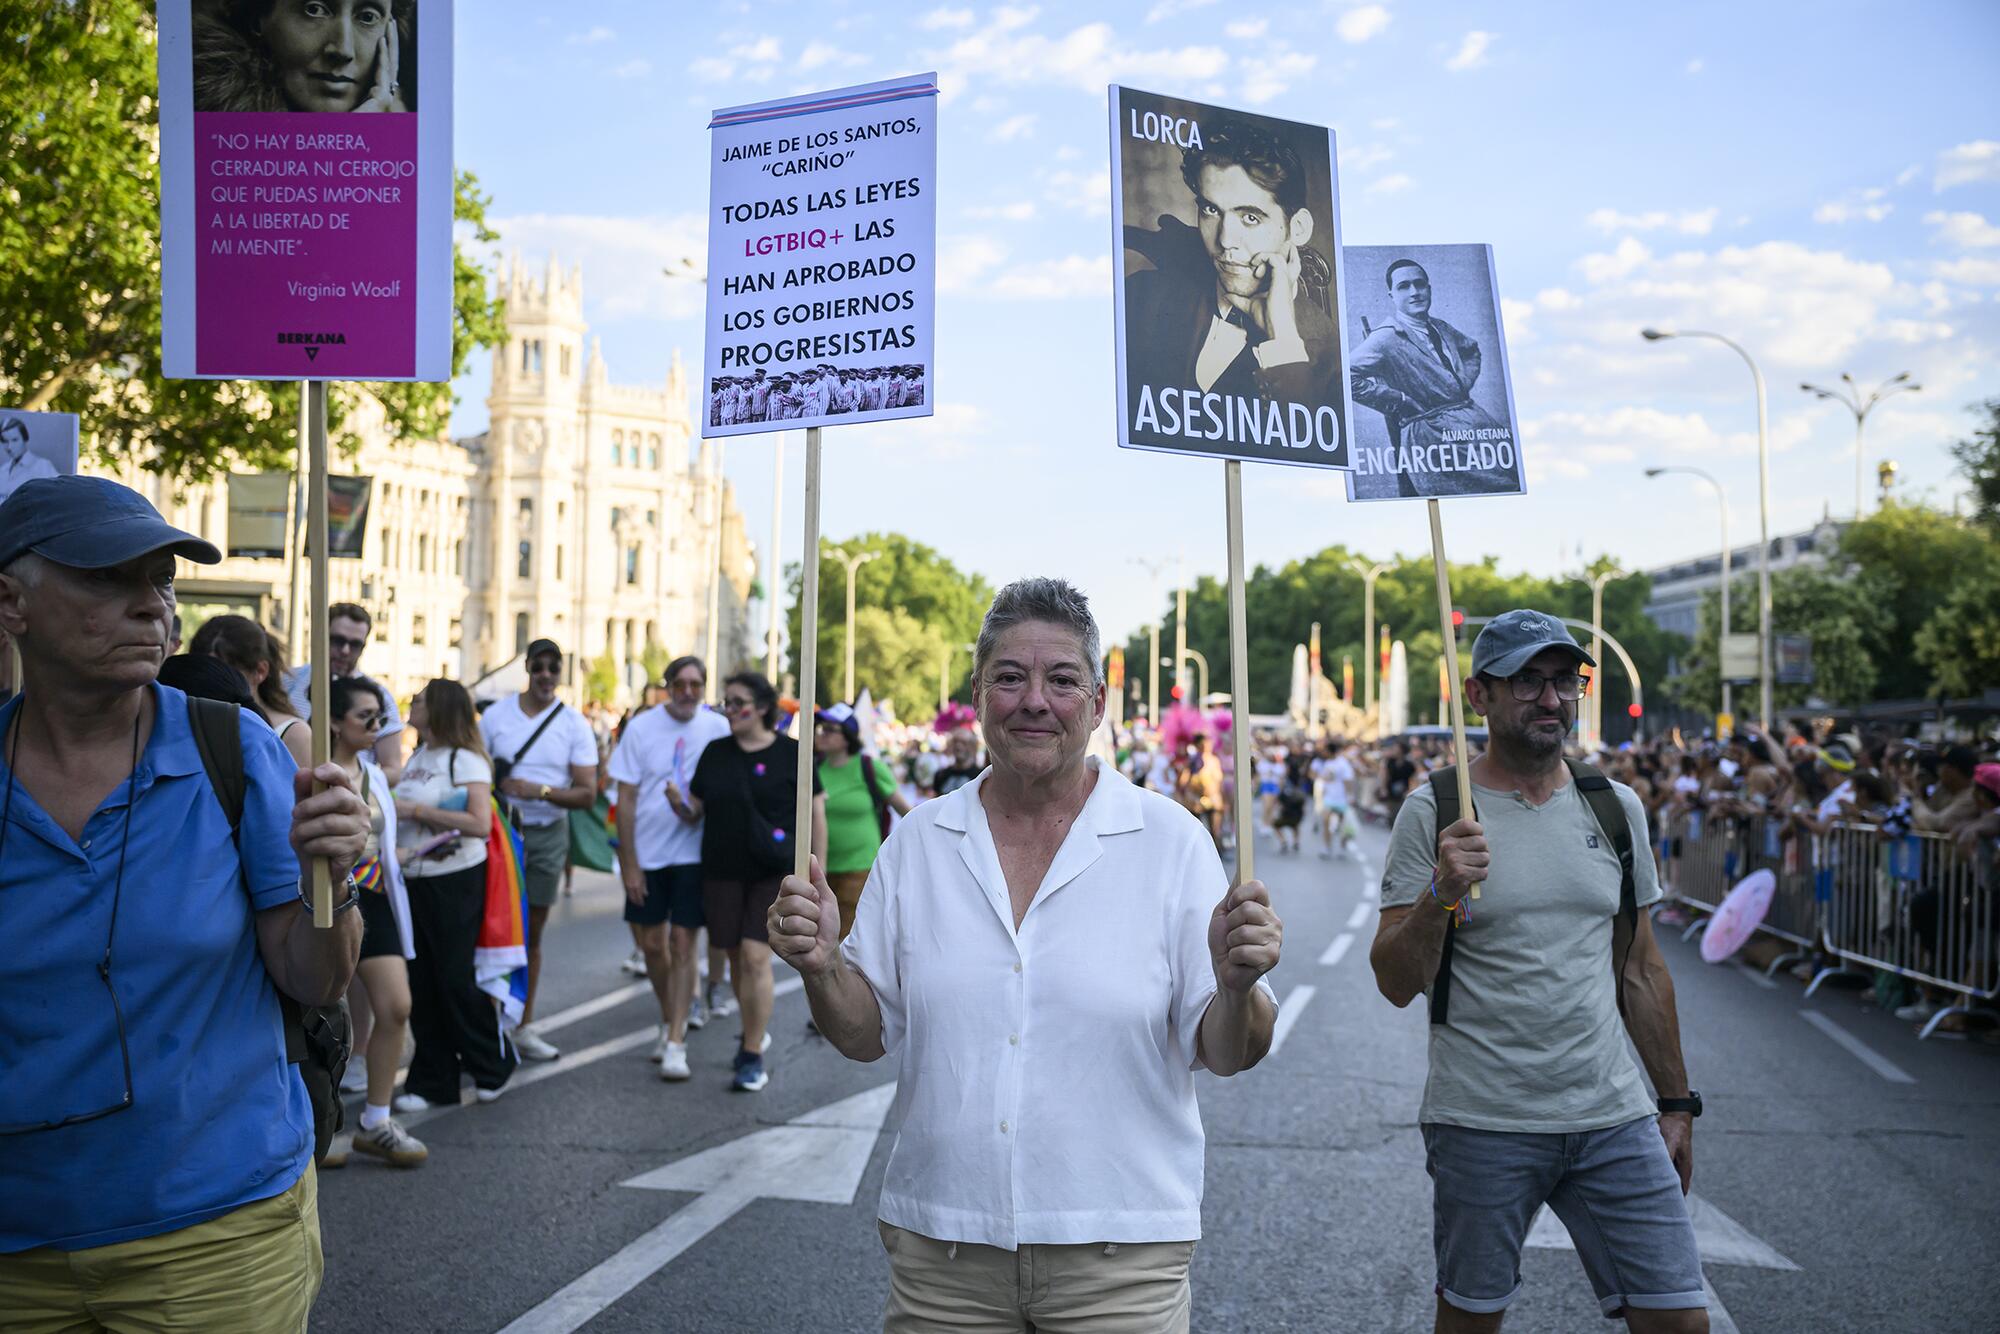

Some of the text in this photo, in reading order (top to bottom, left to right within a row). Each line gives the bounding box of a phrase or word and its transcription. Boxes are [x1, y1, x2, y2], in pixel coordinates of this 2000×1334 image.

[255, 134, 290, 149] HAY
[295, 134, 370, 152] BARRERA,
[722, 117, 921, 162] JAIME DE LOS SANTOS,
[1131, 108, 1203, 151] LORCA
[211, 160, 415, 179] CERRADURA NI CERROJO
[762, 150, 855, 178] “CARIÑO”
[211, 186, 401, 203] QUE PUEDAS IMPONER
[722, 177, 920, 225] TODAS LAS LEYES
[211, 213, 350, 230] A LA LIBERTAD DE
[211, 240, 232, 255] MI
[745, 218, 895, 257] LGTBIQ+ LAS
[724, 252, 916, 296] HAN APROBADO
[287, 280, 401, 302] Virginia Woolf
[724, 290, 914, 332] LOS GOBIERNOS
[277, 333, 346, 345] BERKANA
[721, 324, 916, 369] PROGRESISTAS
[1135, 384, 1339, 452] ASESINADO
[1442, 428, 1511, 442] ÁLVARO RETANA
[1355, 441, 1514, 476] ENCARCELADO
